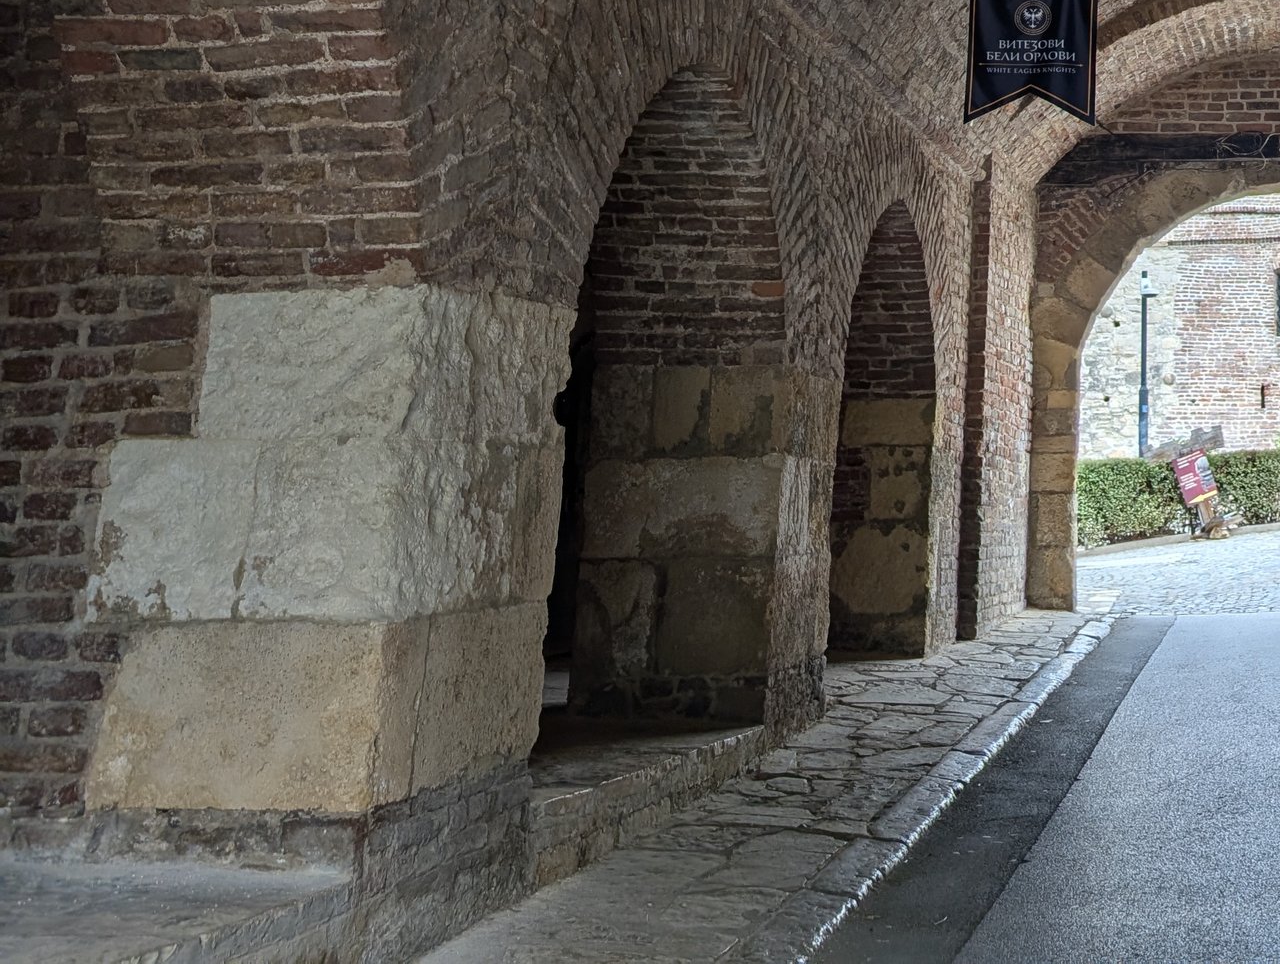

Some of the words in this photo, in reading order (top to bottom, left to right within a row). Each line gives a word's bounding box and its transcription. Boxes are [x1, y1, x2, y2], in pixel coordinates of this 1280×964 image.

[998, 39, 1065, 52] ВИТЕЗОВИ
[986, 51, 1020, 61] БЕЛИ
[1023, 51, 1076, 63] ОРЛОВИ
[1042, 66, 1077, 74] KNIGHTS
